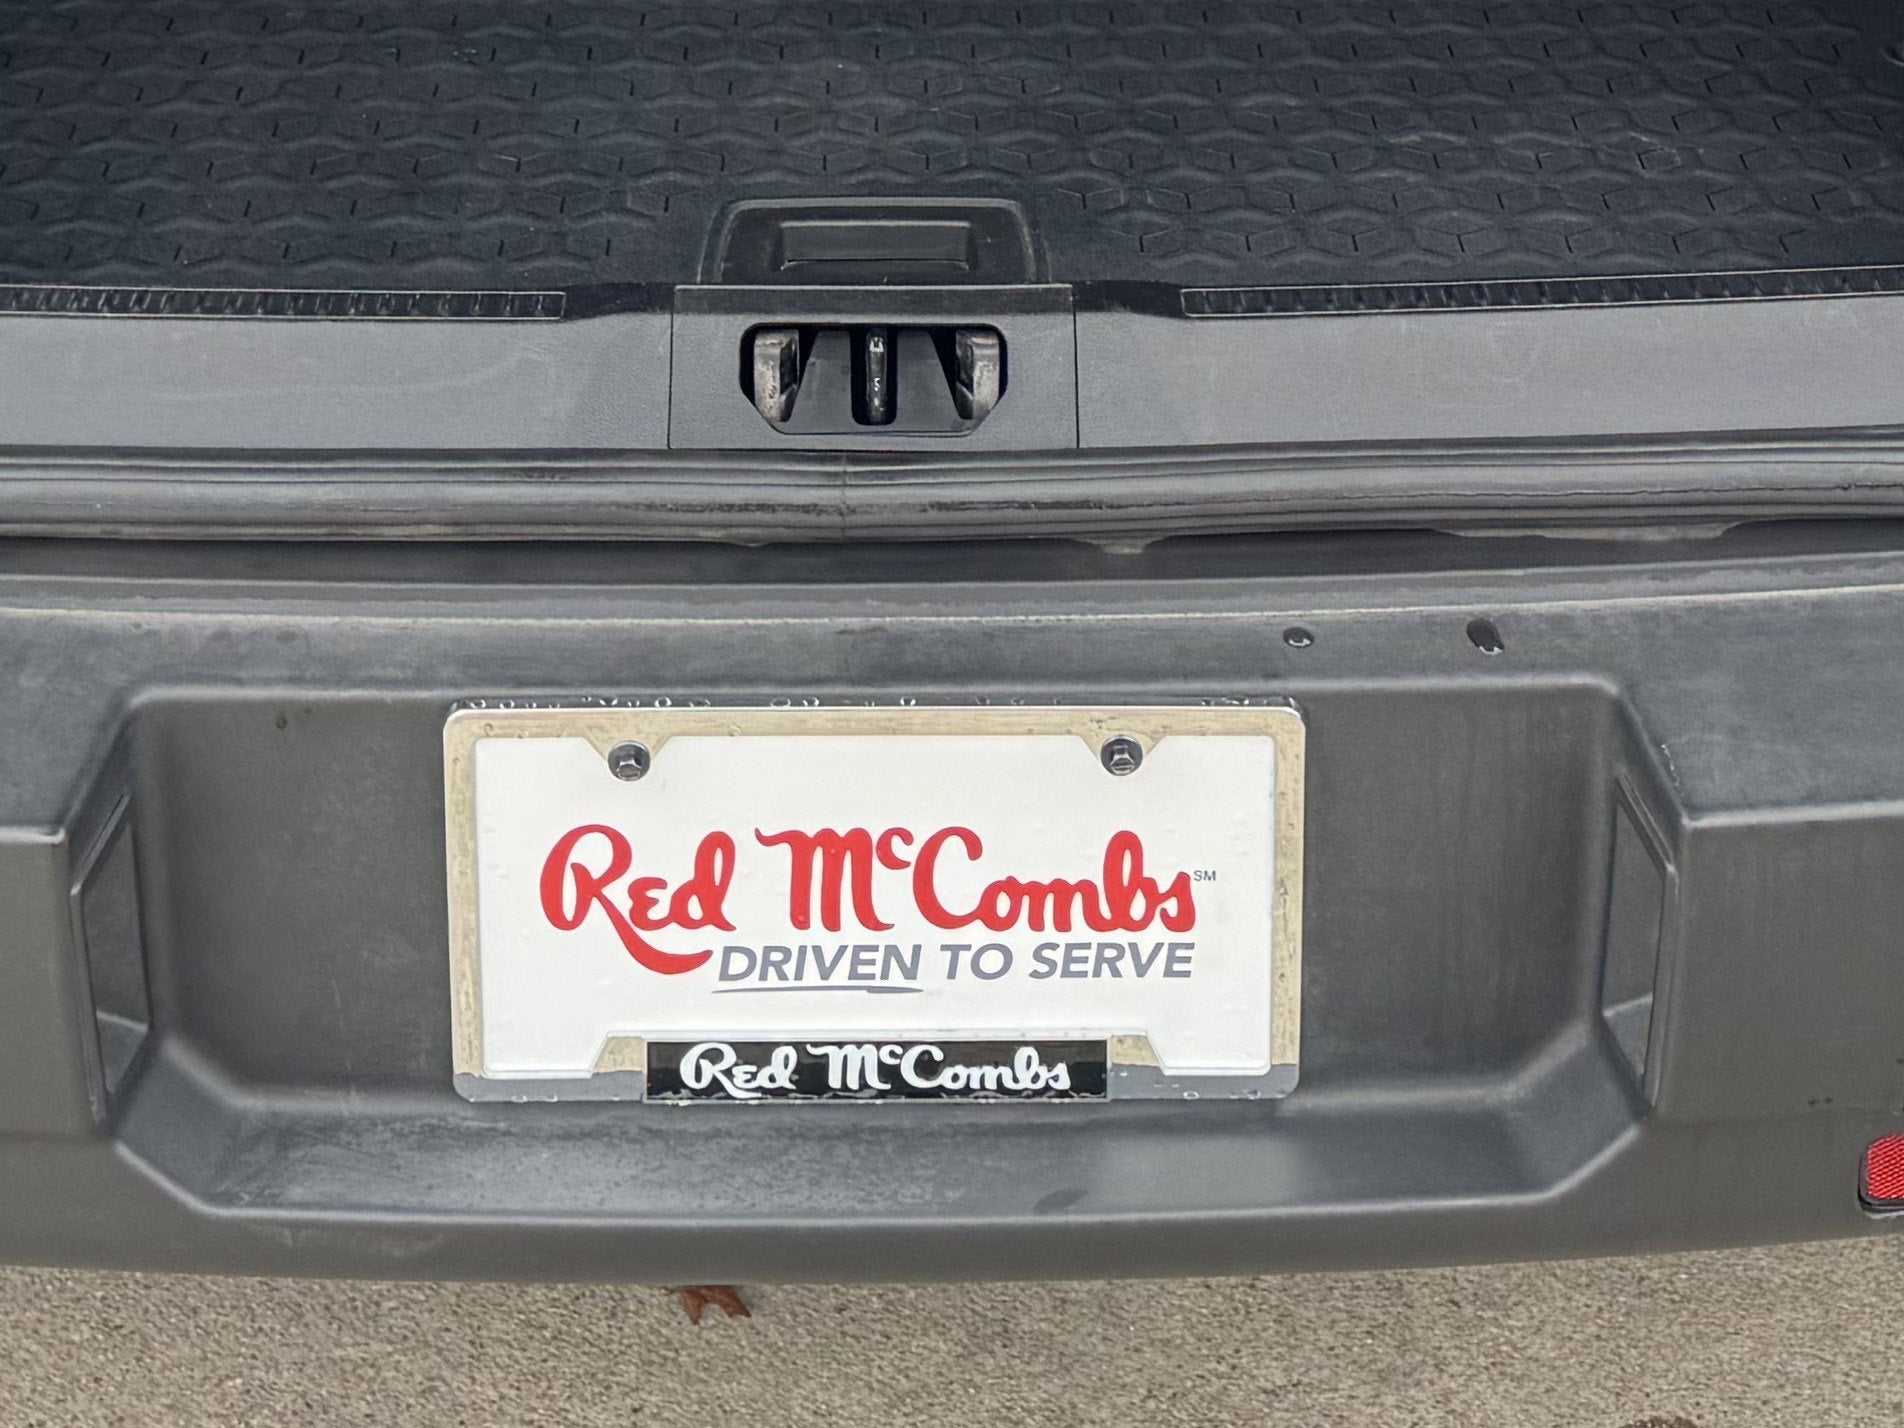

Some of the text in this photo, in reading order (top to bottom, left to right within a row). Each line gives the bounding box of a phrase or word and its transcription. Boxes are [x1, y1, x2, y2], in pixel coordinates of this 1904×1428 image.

[540, 824, 736, 976] Red
[754, 826, 1197, 933] McCombs
[717, 941, 1197, 982] DRIVEN TO SERVE
[679, 1042, 1072, 1100] Red McCombs
